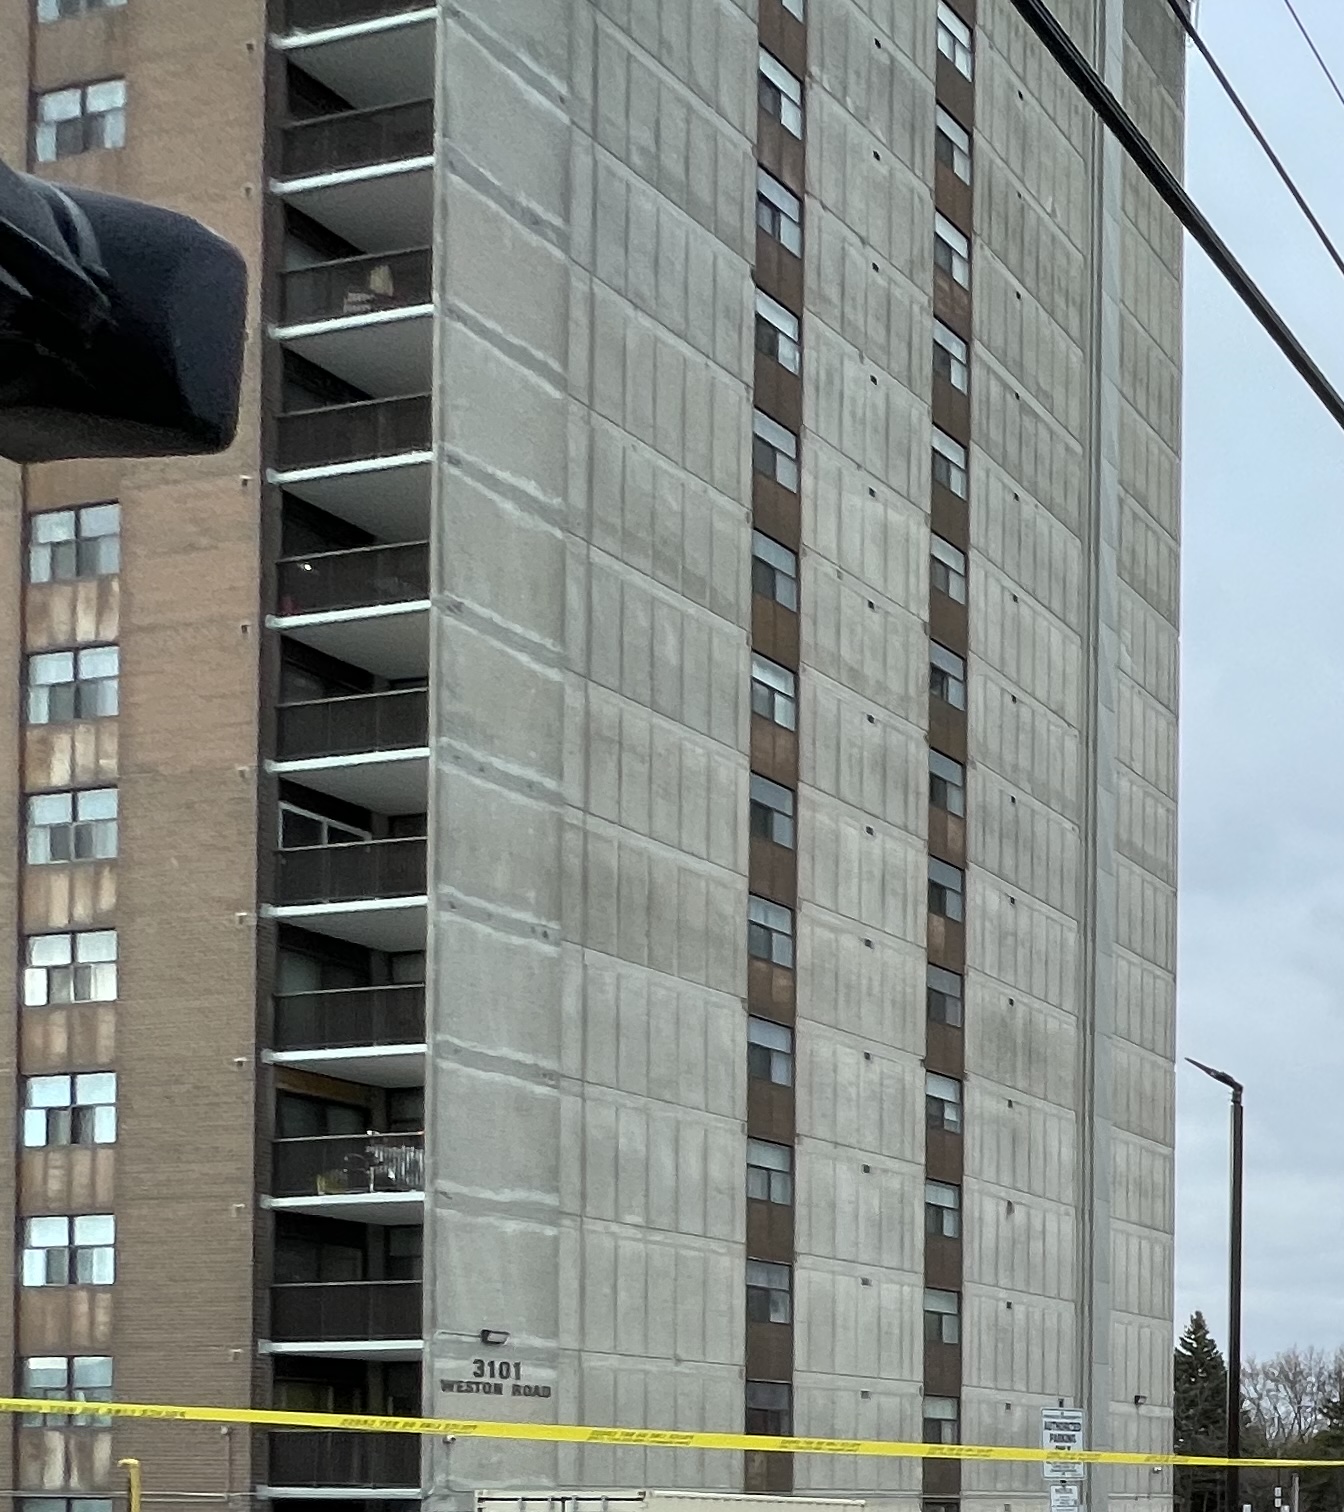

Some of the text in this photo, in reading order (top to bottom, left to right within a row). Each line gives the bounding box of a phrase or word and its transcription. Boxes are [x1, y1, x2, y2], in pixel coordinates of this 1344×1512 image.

[472, 1359, 522, 1380] 3101
[440, 1379, 552, 1398] WESTON ROAD
